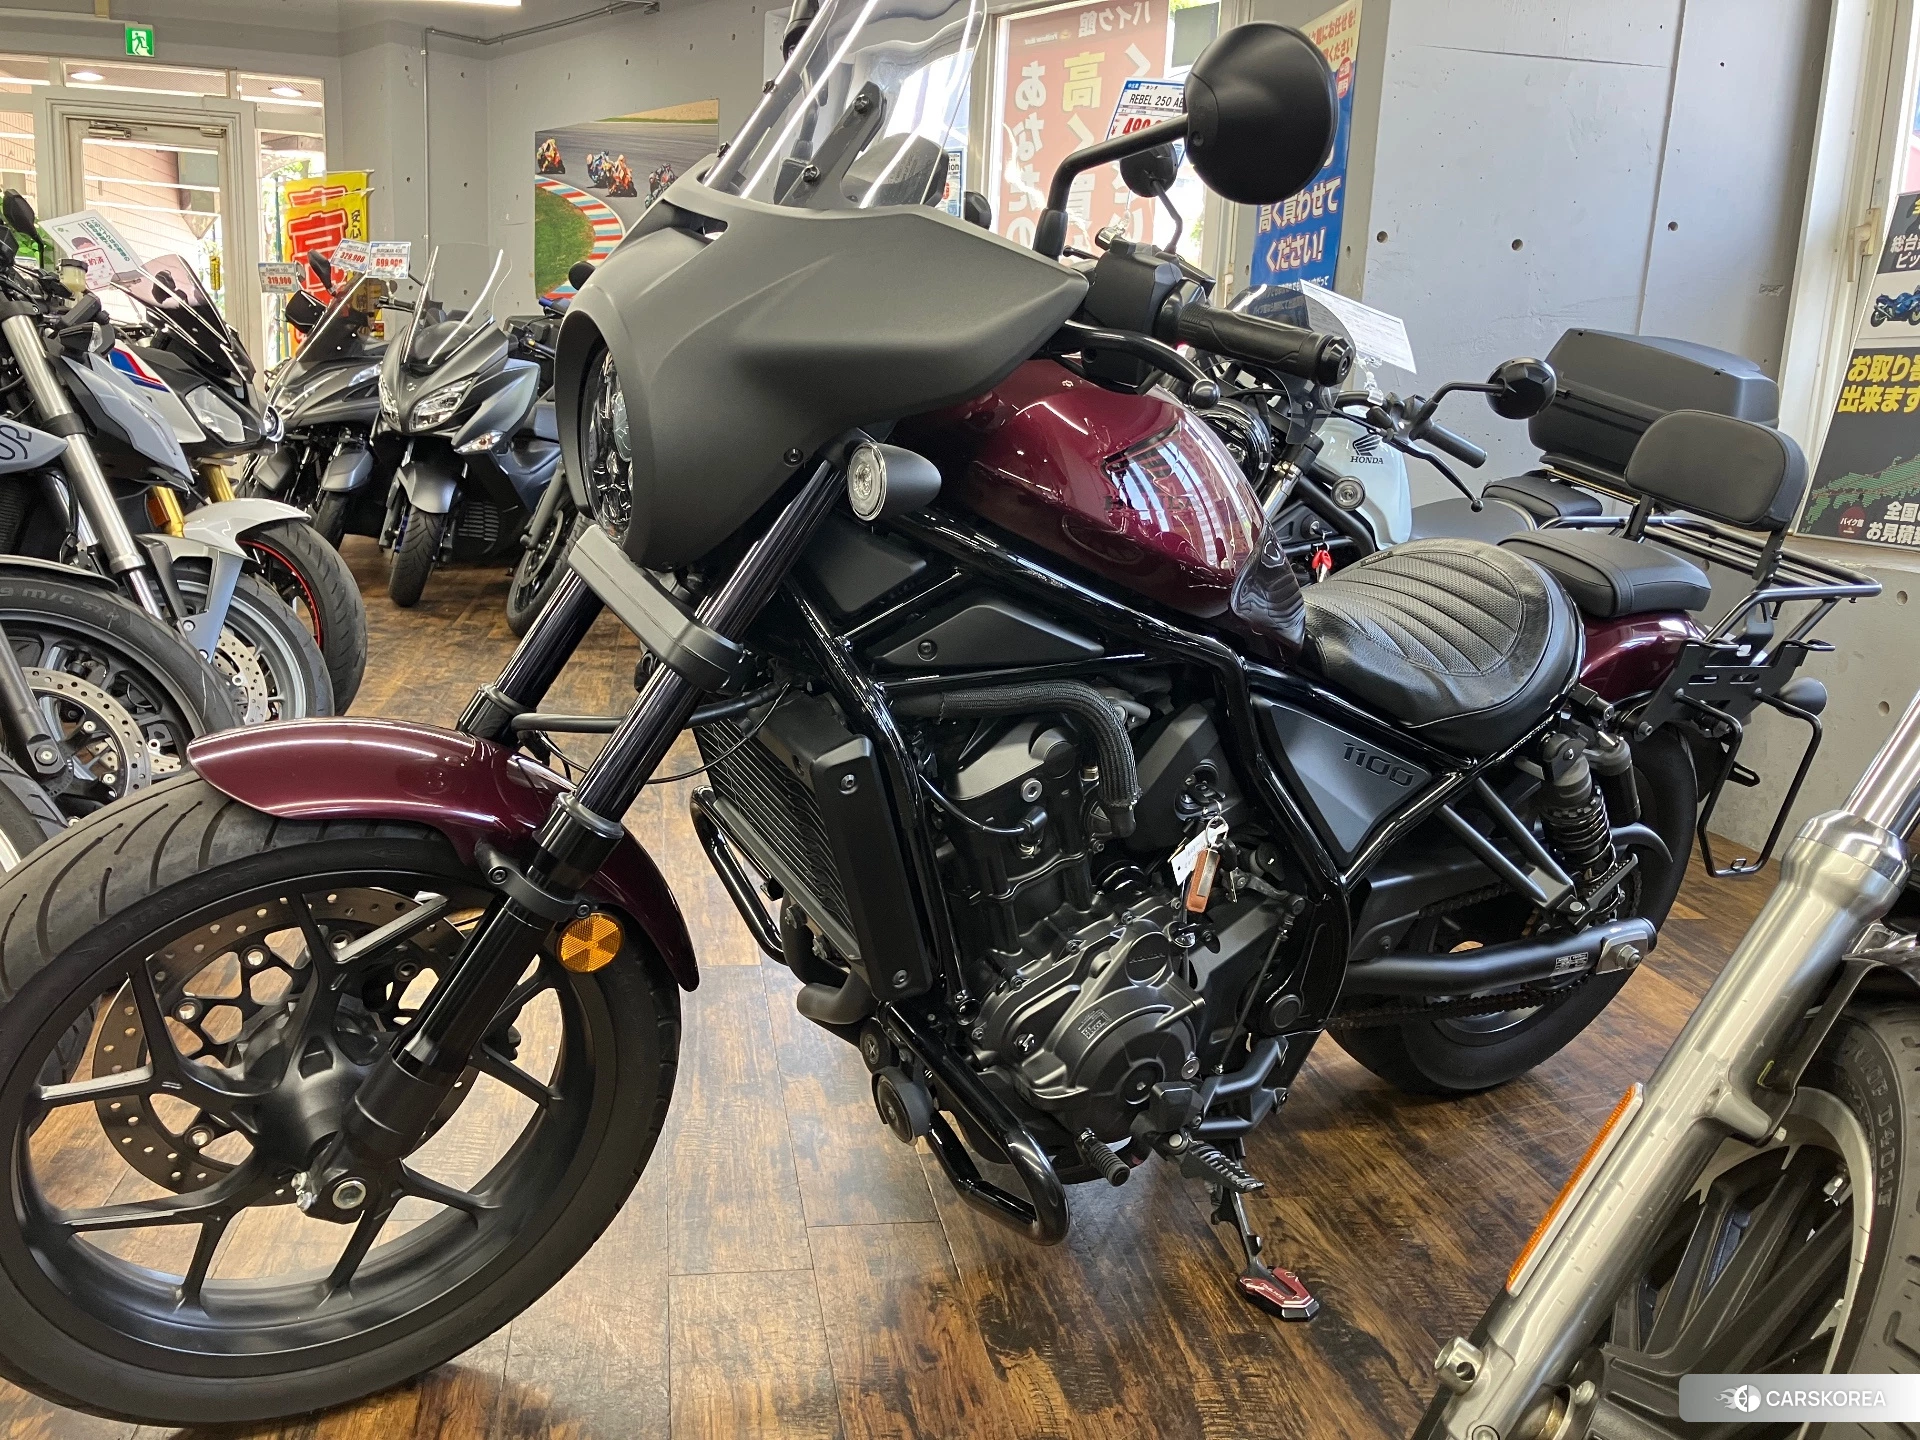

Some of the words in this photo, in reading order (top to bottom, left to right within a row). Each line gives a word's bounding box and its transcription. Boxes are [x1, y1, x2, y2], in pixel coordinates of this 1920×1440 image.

[1129, 93, 1153, 106] REBEL
[1155, 95, 1172, 107] 250
[1265, 228, 1325, 271] ください!
[1890, 233, 1920, 254] 総台
[1350, 455, 1385, 465] HONDA
[1883, 501, 1920, 522] 全国
[1343, 742, 1415, 788] 1100
